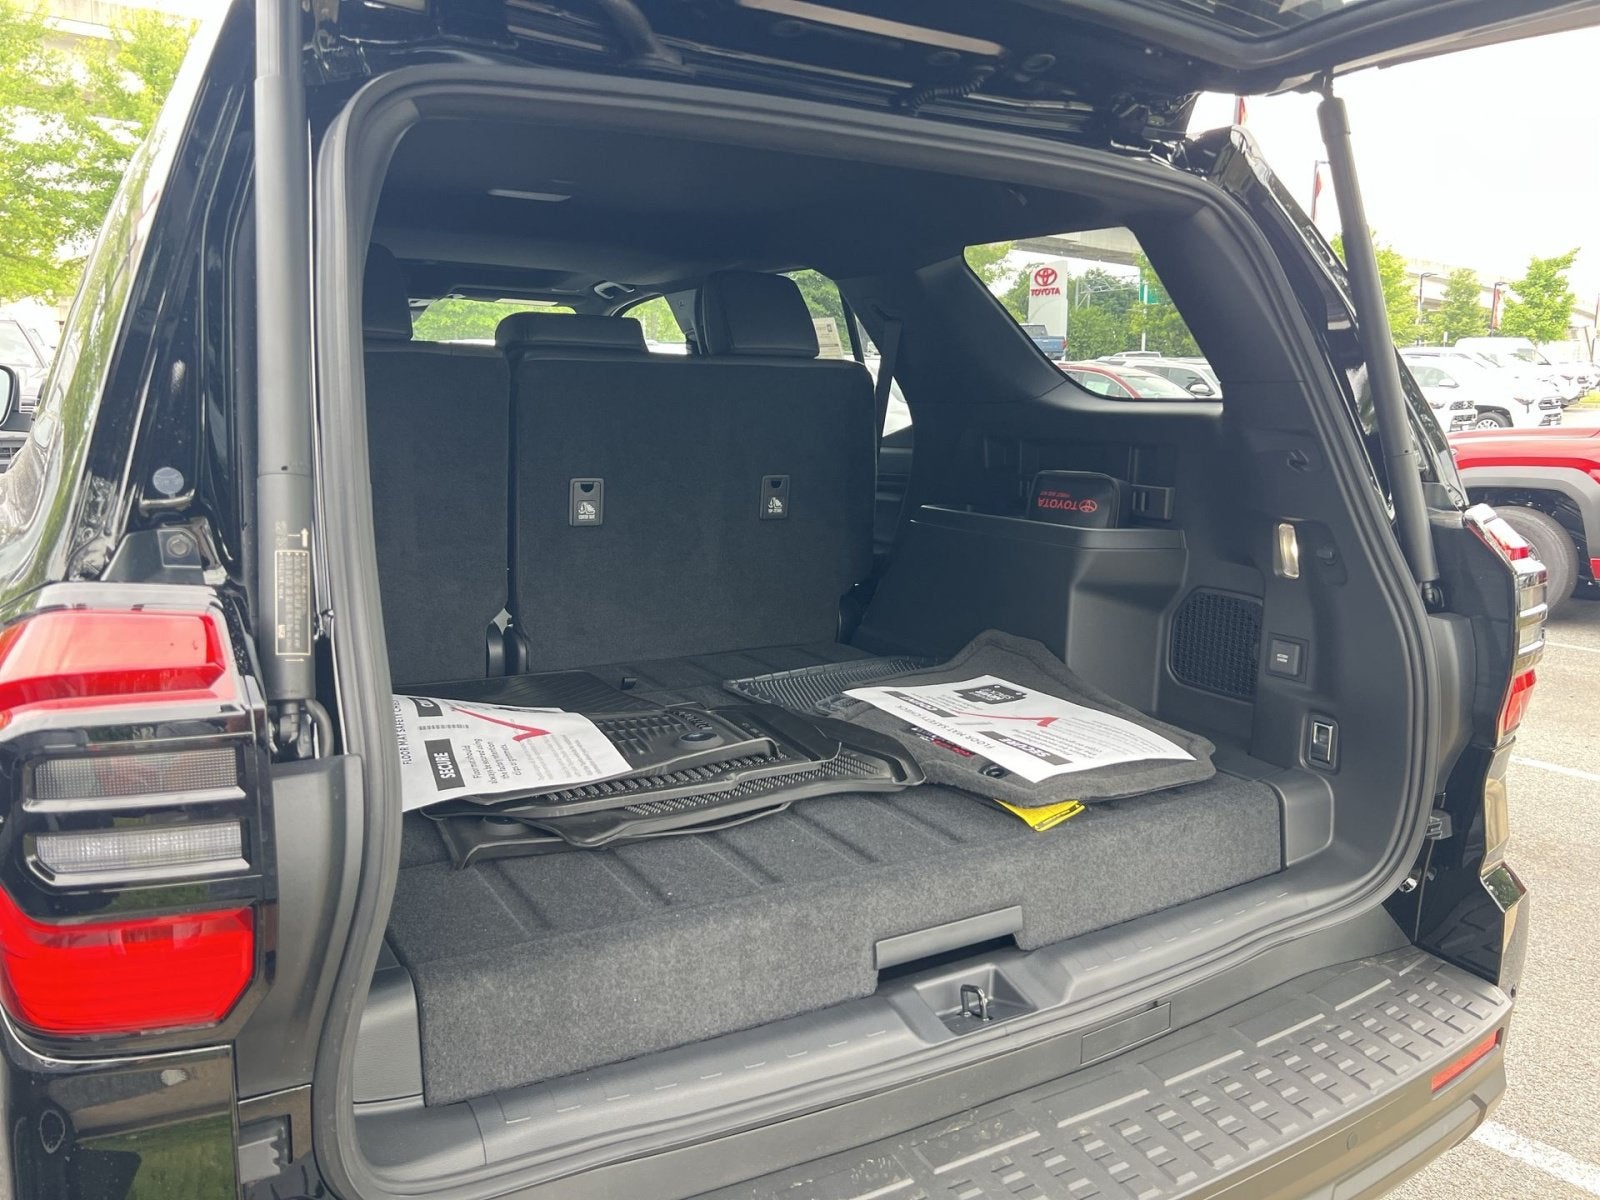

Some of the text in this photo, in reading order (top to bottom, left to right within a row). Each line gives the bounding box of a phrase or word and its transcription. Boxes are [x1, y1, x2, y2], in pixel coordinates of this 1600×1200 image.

[1030, 287, 1061, 297] TOYOTA
[1038, 497, 1077, 510] TOYOTA
[965, 735, 996, 750] FLOOR
[998, 737, 1051, 758] SECURE
[399, 747, 412, 766] FLOOR
[433, 752, 456, 779] SECURE
